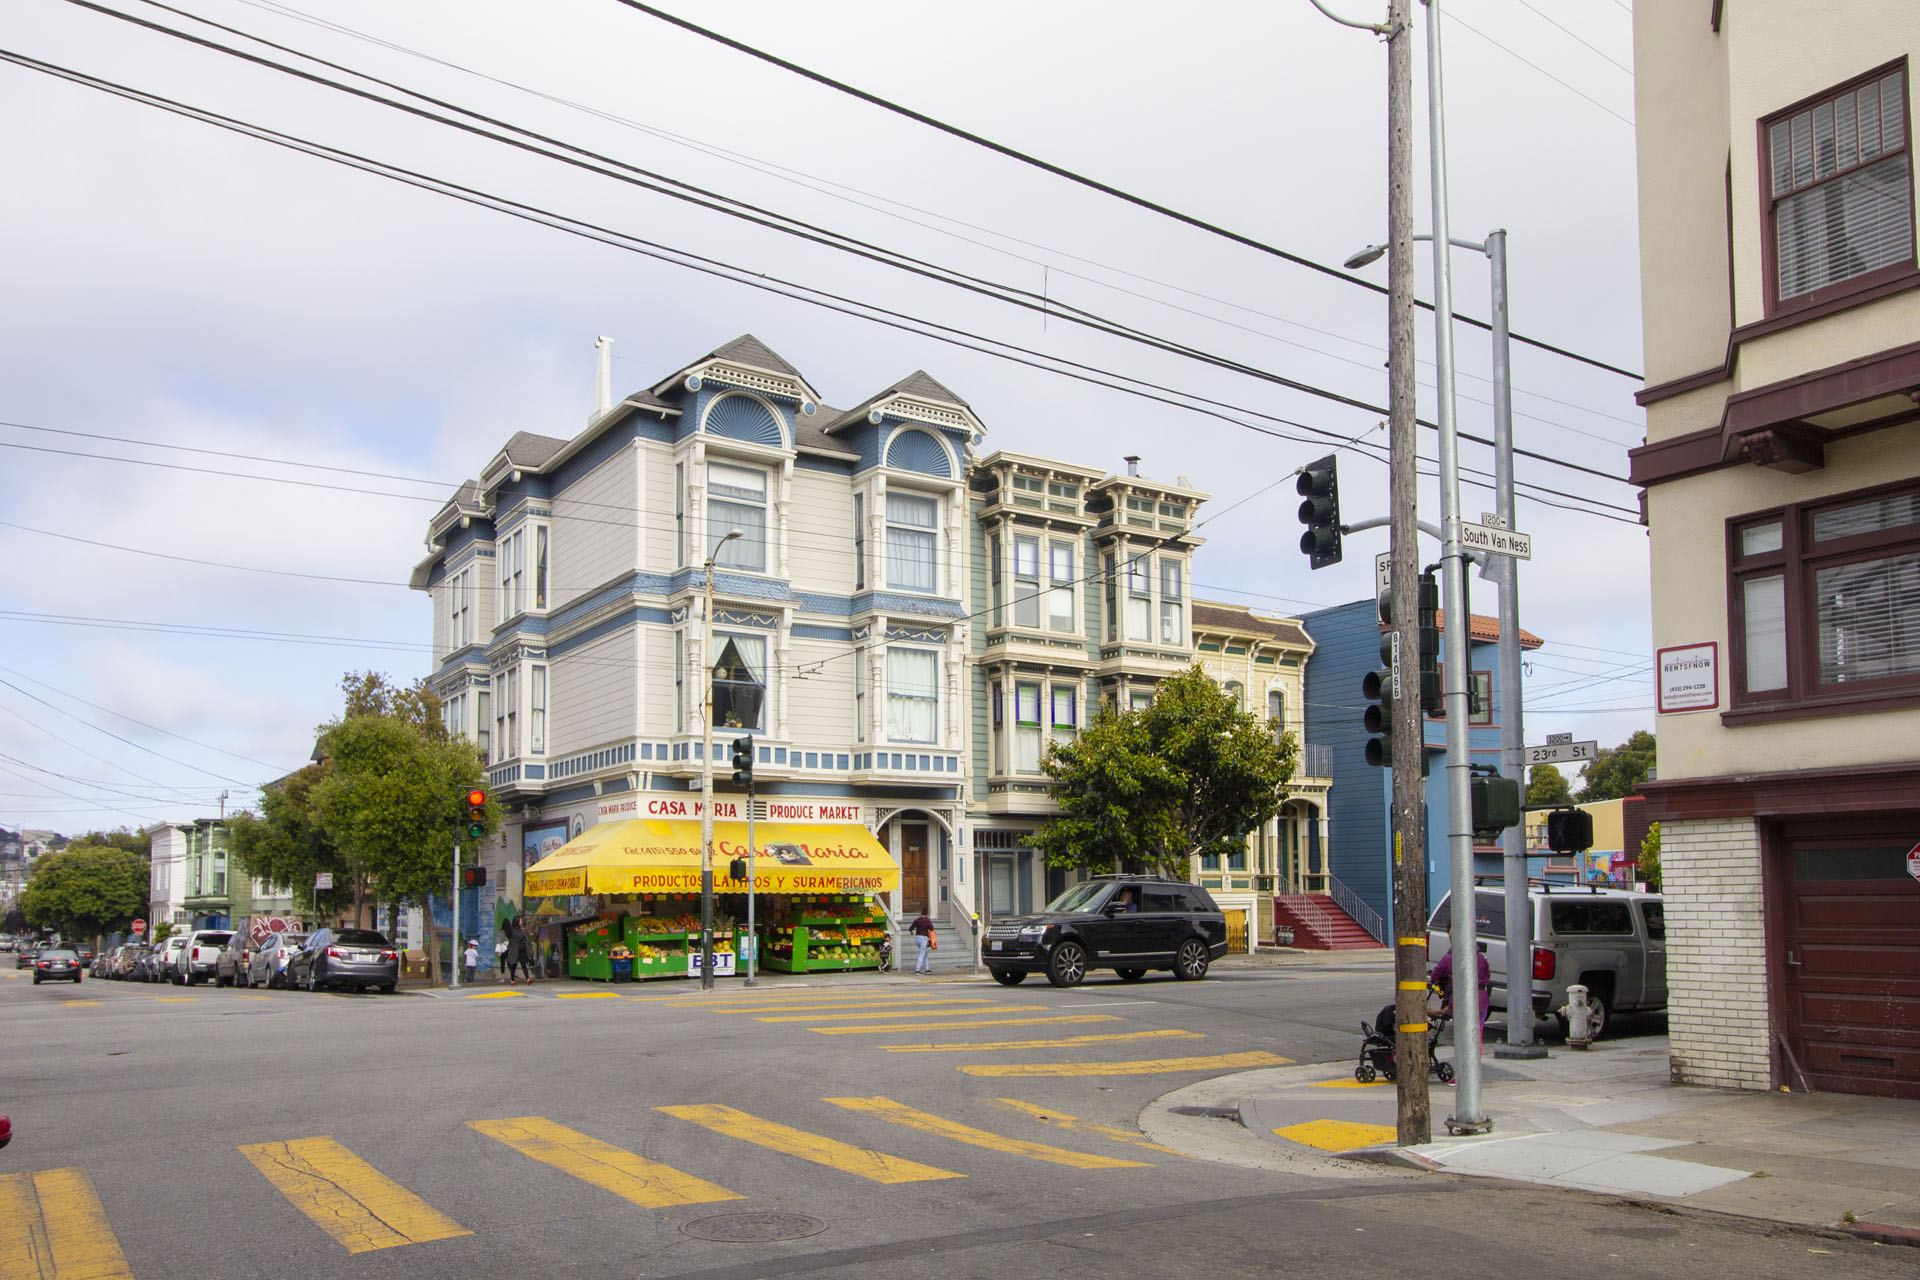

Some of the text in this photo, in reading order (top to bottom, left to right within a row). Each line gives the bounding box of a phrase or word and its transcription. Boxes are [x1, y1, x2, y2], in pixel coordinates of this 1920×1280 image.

[1485, 514, 1501, 526] 1200
[1464, 527, 1528, 553] South Van Ness
[1533, 746, 1586, 761] 23rd St
[598, 801, 637, 816] CASA MARIA PRODUCE
[648, 801, 860, 820] CASA MRIA PRODUCE MARKET
[640, 847, 665, 857] (415)
[666, 847, 718, 857] 550-682
[778, 876, 786, 888] Y
[793, 877, 882, 888] SURAMERICANOS
[132, 922, 146, 930] STOP
[692, 953, 733, 968] EBT
